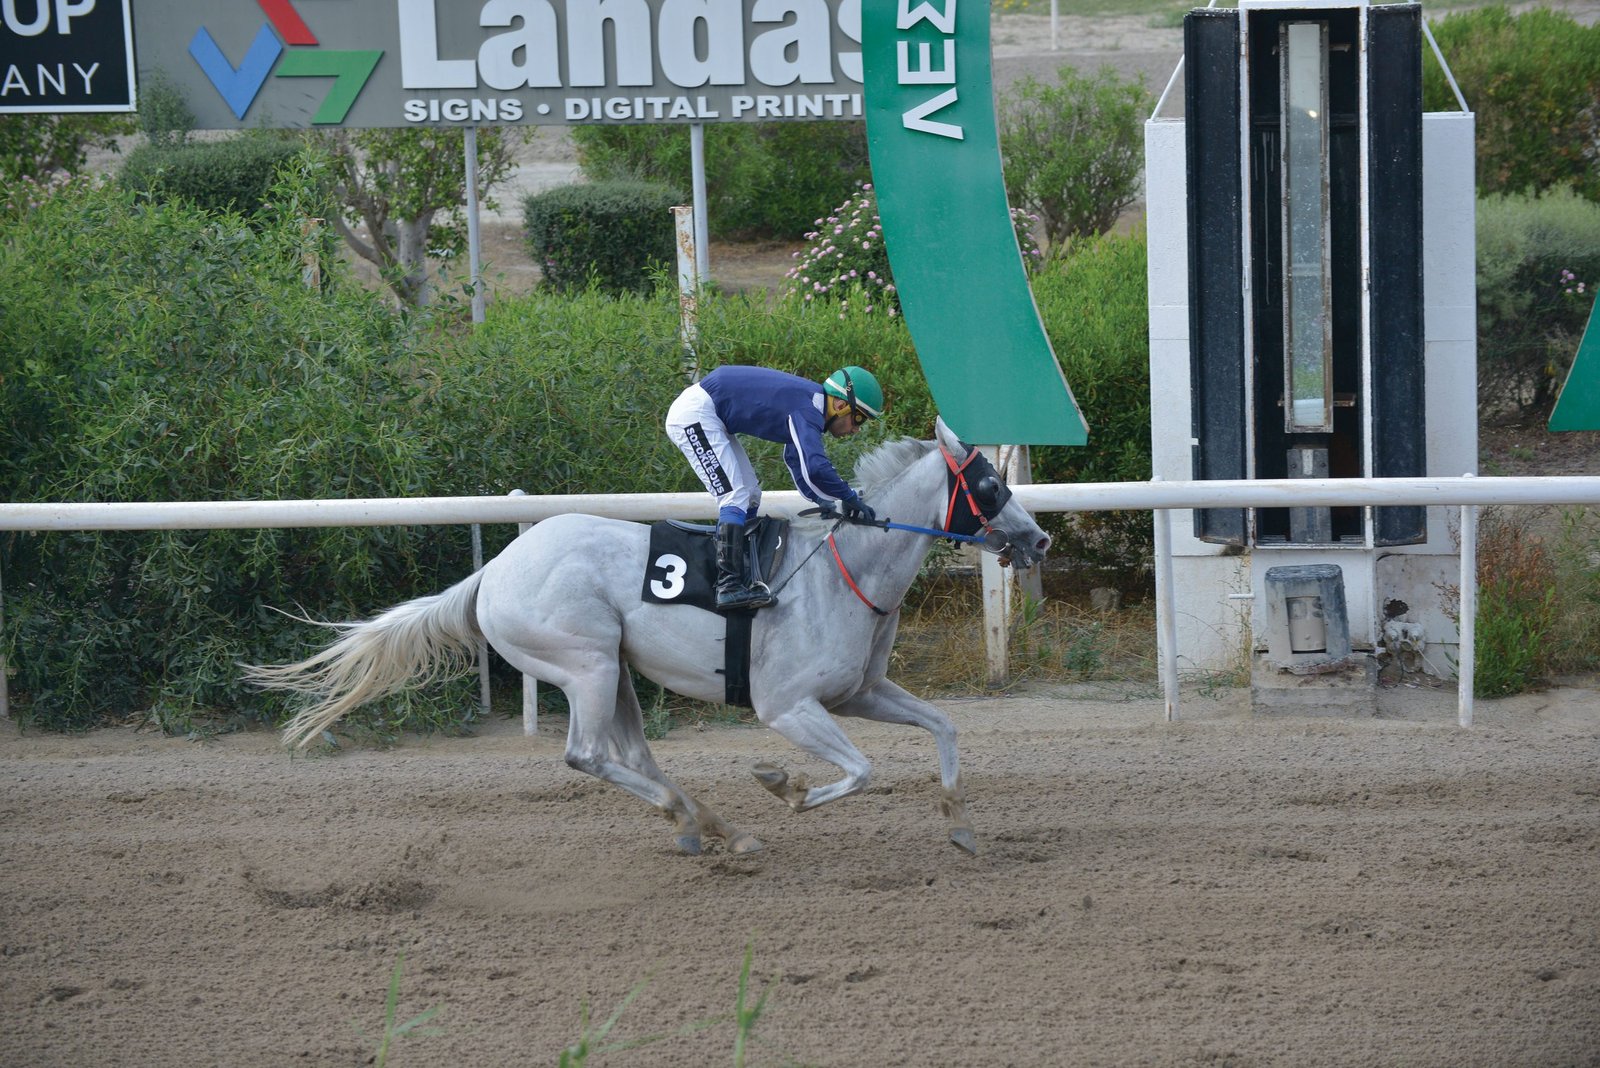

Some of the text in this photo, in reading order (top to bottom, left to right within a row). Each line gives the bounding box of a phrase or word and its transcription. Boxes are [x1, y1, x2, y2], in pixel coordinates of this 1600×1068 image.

[0, 0, 97, 37] UP
[0, 62, 100, 97] ANY
[404, 98, 524, 122] SIGNS
[565, 95, 720, 120] DIGITAL
[686, 427, 725, 494] SOFOKLEOUS
[705, 449, 720, 469] CAVA
[650, 553, 688, 600] 3
